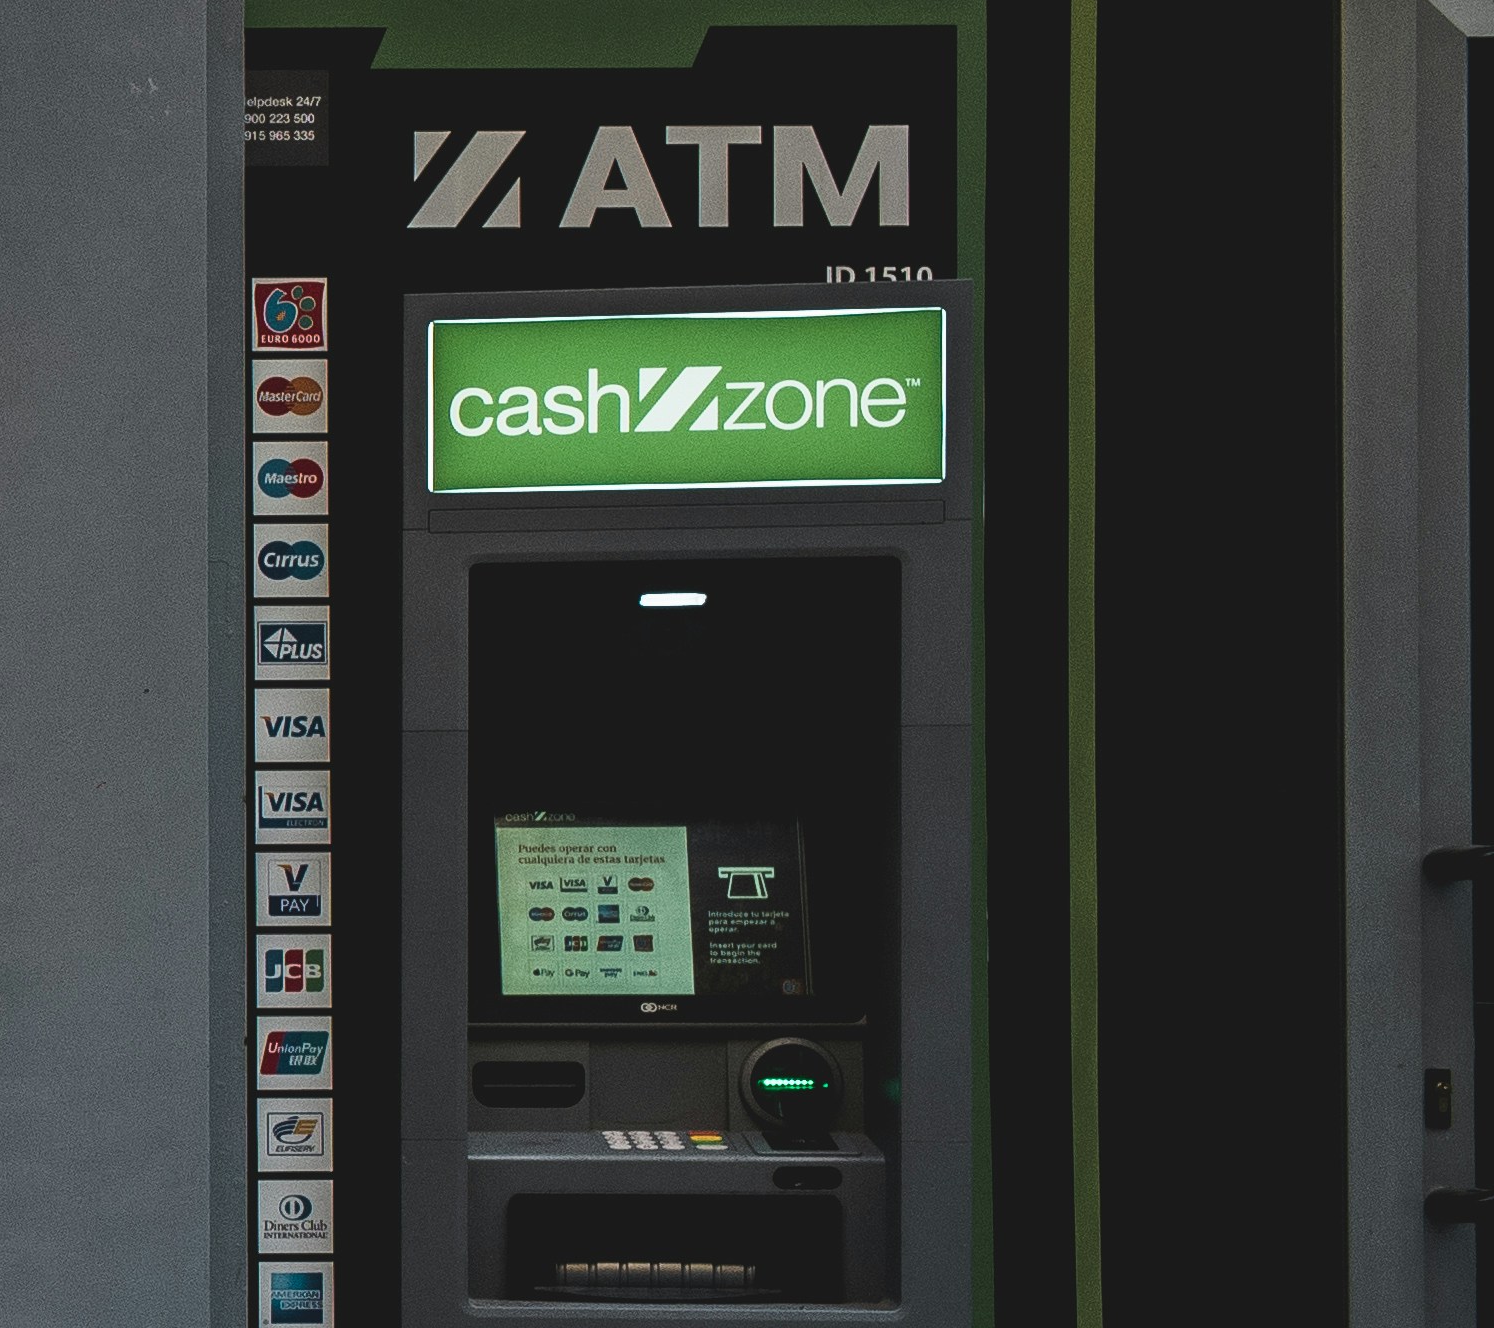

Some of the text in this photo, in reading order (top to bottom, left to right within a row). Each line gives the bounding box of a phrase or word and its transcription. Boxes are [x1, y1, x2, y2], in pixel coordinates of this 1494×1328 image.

[246, 96, 322, 109] elpdesk 24/7
[244, 113, 315, 124] 900 223 500
[244, 130, 315, 141] 915 965 335
[559, 125, 909, 228] ATM
[826, 266, 933, 283] ID 1510
[261, 334, 321, 344] EURO 6000
[258, 390, 322, 402] MasterCard
[264, 472, 317, 484] Maestro
[263, 552, 320, 568] Cirrus
[279, 643, 323, 660] PLUS
[260, 715, 326, 738] VISA
[264, 792, 324, 812] VISA
[518, 844, 556, 853] Puedes
[559, 845, 593, 855] operar
[518, 855, 666, 866] cualquiera de estas tarjetas
[277, 863, 309, 892] V
[564, 878, 586, 887] VISA
[529, 881, 554, 890] VISA
[280, 898, 310, 912] PAY
[265, 963, 322, 979] JCB
[268, 1042, 324, 1058] UnionPay
[264, 1220, 328, 1232] Diners Club
